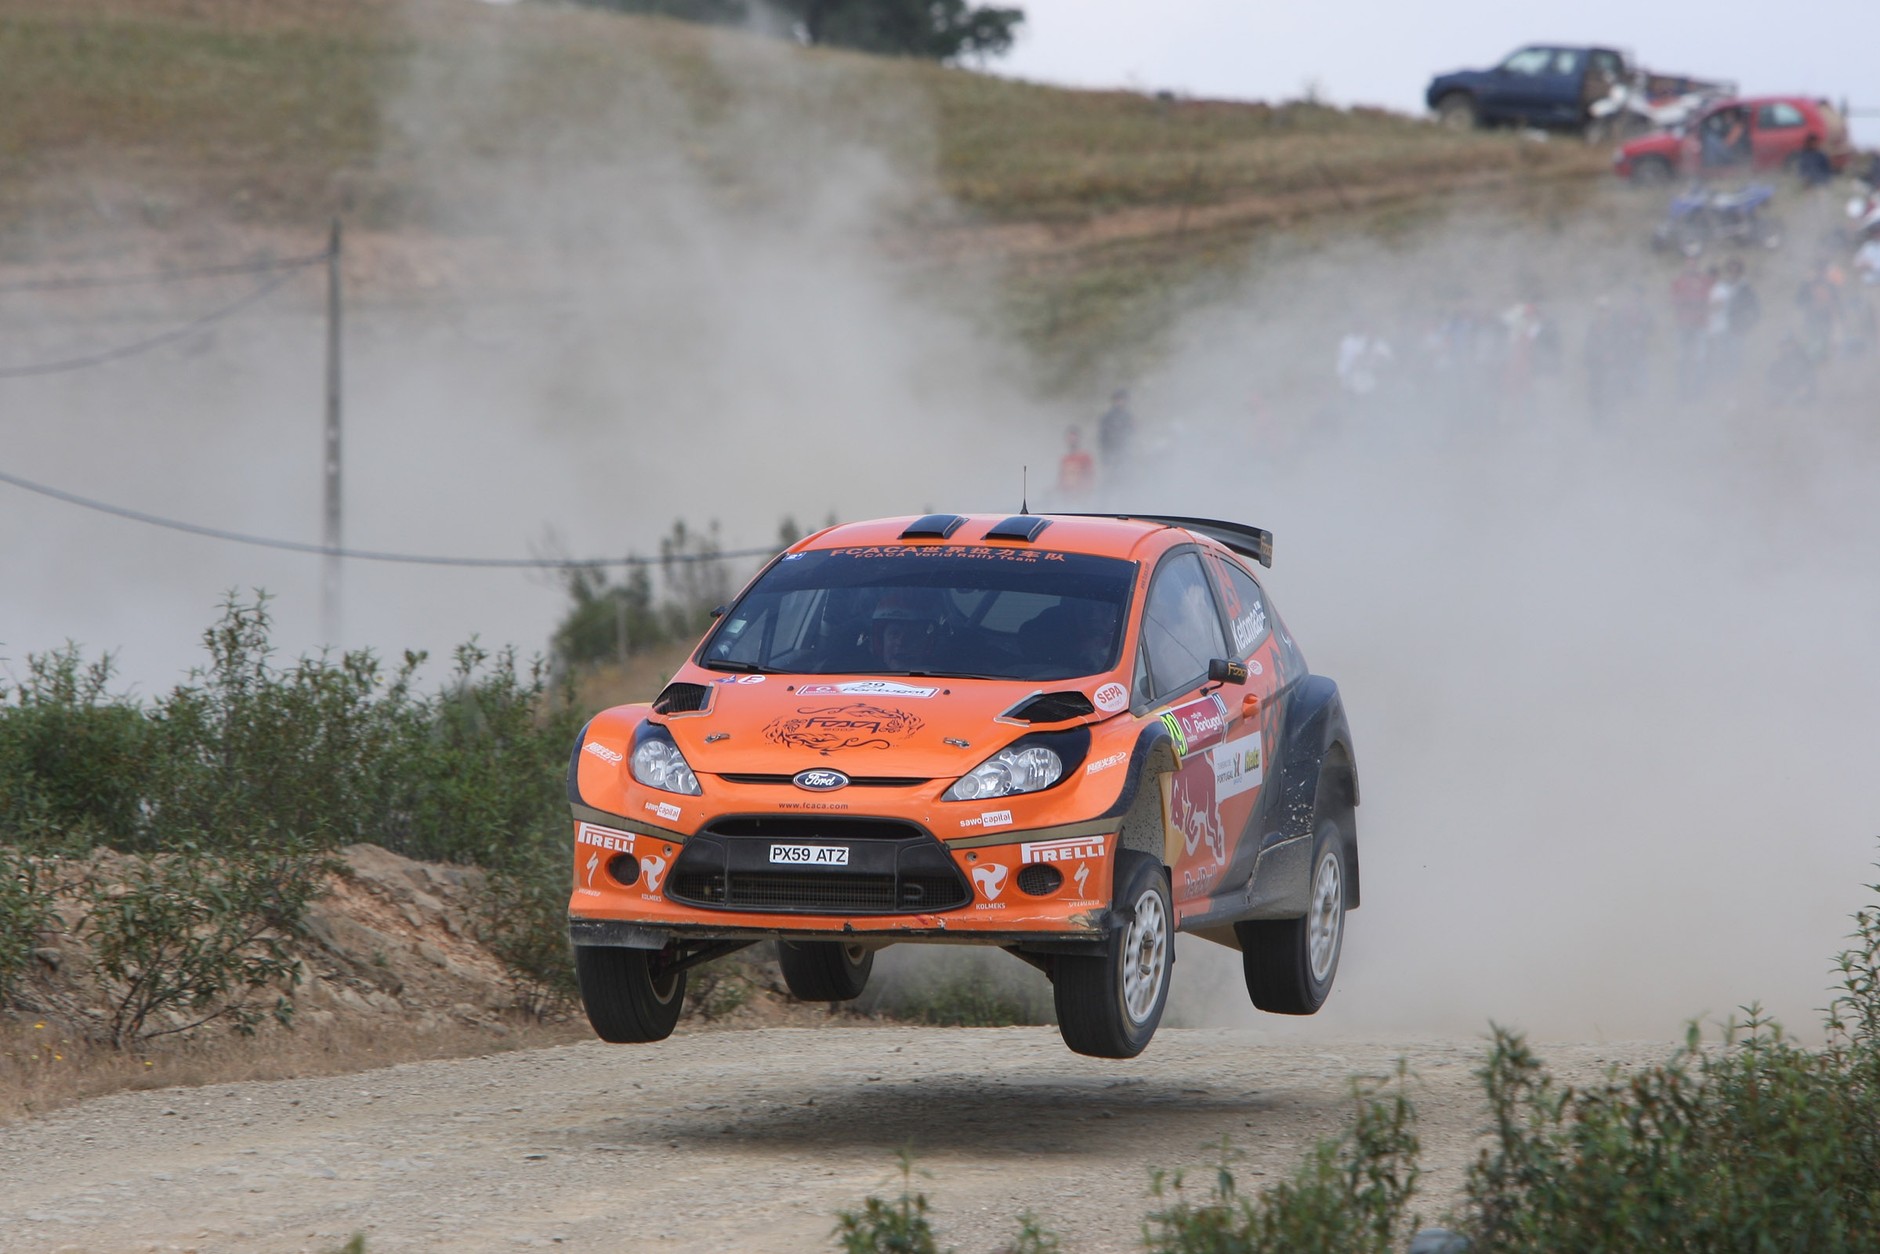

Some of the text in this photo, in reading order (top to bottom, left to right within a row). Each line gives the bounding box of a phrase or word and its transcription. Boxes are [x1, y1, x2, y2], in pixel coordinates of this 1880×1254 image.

[1000, 555, 1036, 563] Team
[842, 686, 926, 696] Portugal
[1097, 685, 1123, 704] SEPA
[1194, 712, 1223, 733] Portugal
[804, 773, 836, 786] Ford
[778, 802, 849, 810] www.fcaca.com
[960, 813, 1011, 827] sawo capital
[578, 822, 636, 854] PIRELLI
[772, 847, 847, 863] PX59 ATZ
[1021, 835, 1105, 864] PIRELLI
